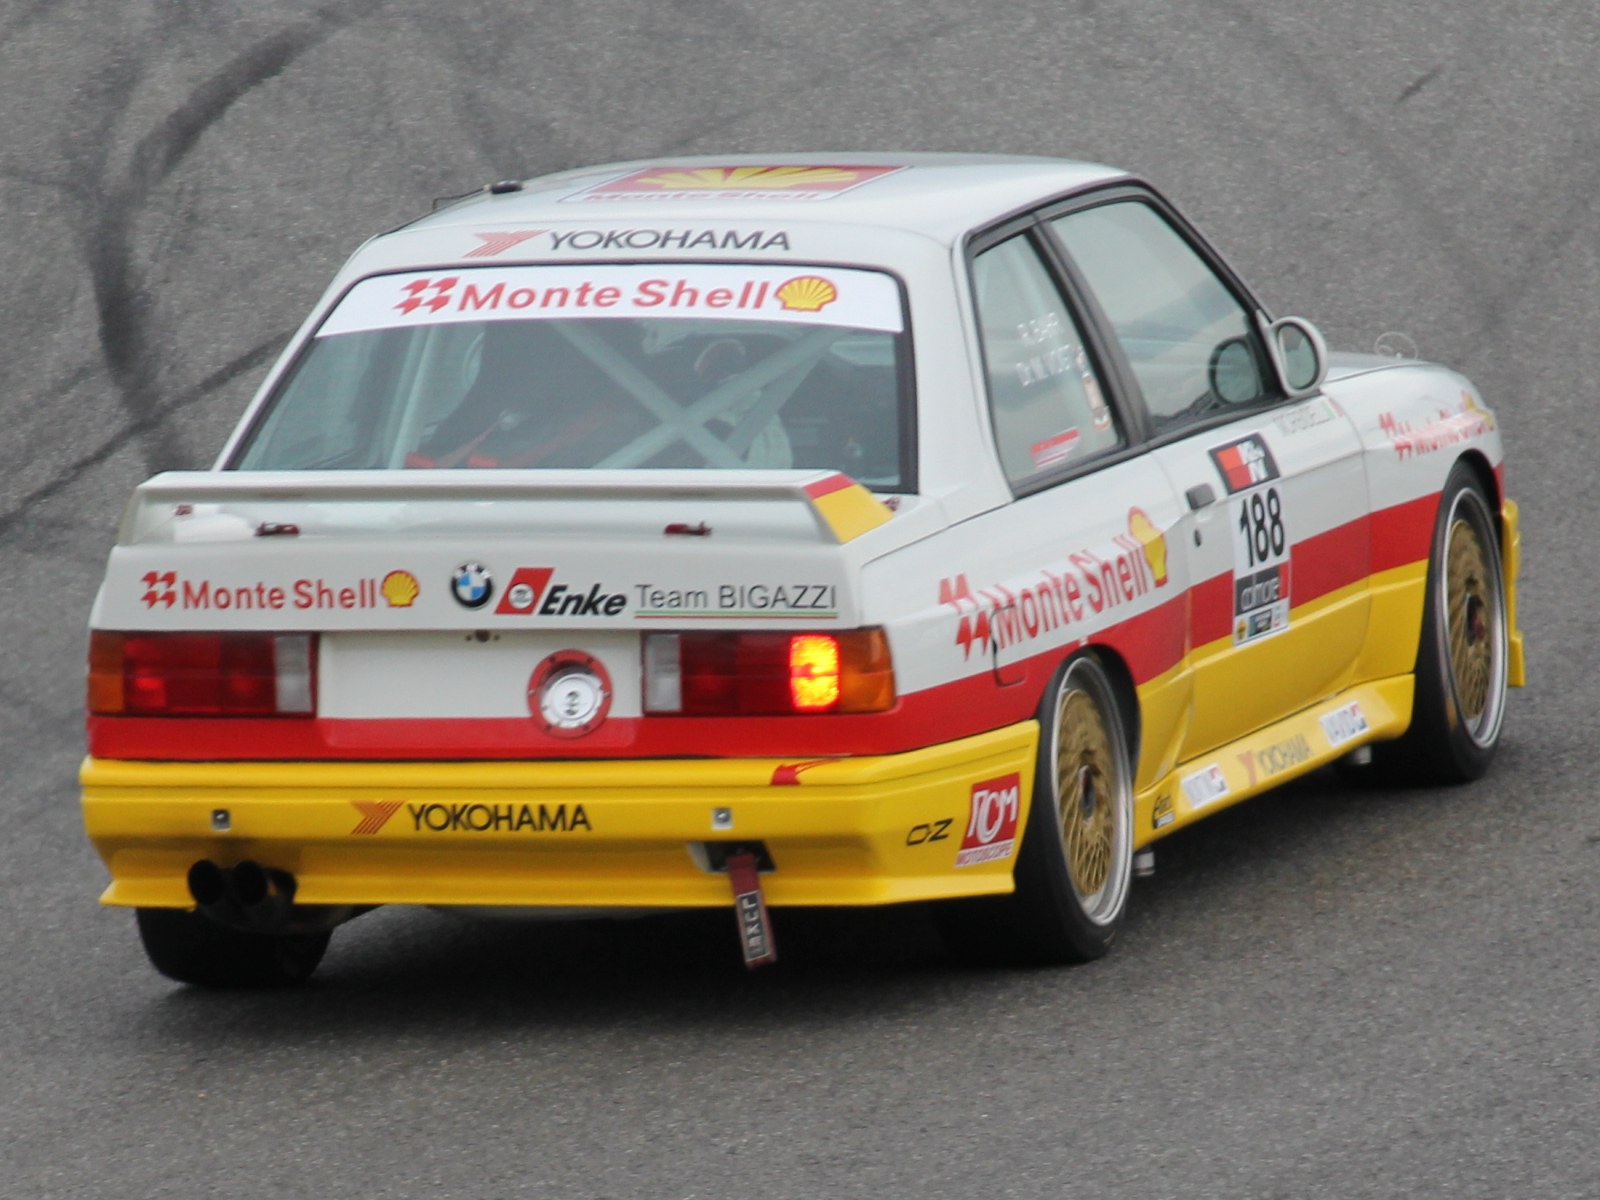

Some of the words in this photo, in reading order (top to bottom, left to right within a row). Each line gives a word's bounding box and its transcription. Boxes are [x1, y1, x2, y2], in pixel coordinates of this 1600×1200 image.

[551, 229, 790, 251] YOKOHAMA
[457, 281, 622, 312] Monte
[631, 278, 771, 309] Shell
[1239, 487, 1285, 569] 188
[182, 579, 286, 610] Monte
[292, 578, 377, 610] Shell
[537, 582, 628, 617] Enke
[634, 583, 709, 609] Team
[717, 584, 837, 610] BIGAZZI
[977, 569, 1084, 650] Monte
[1068, 532, 1148, 614] Shell
[407, 802, 593, 832] YOKOHAMA
[906, 817, 955, 847] OZ
